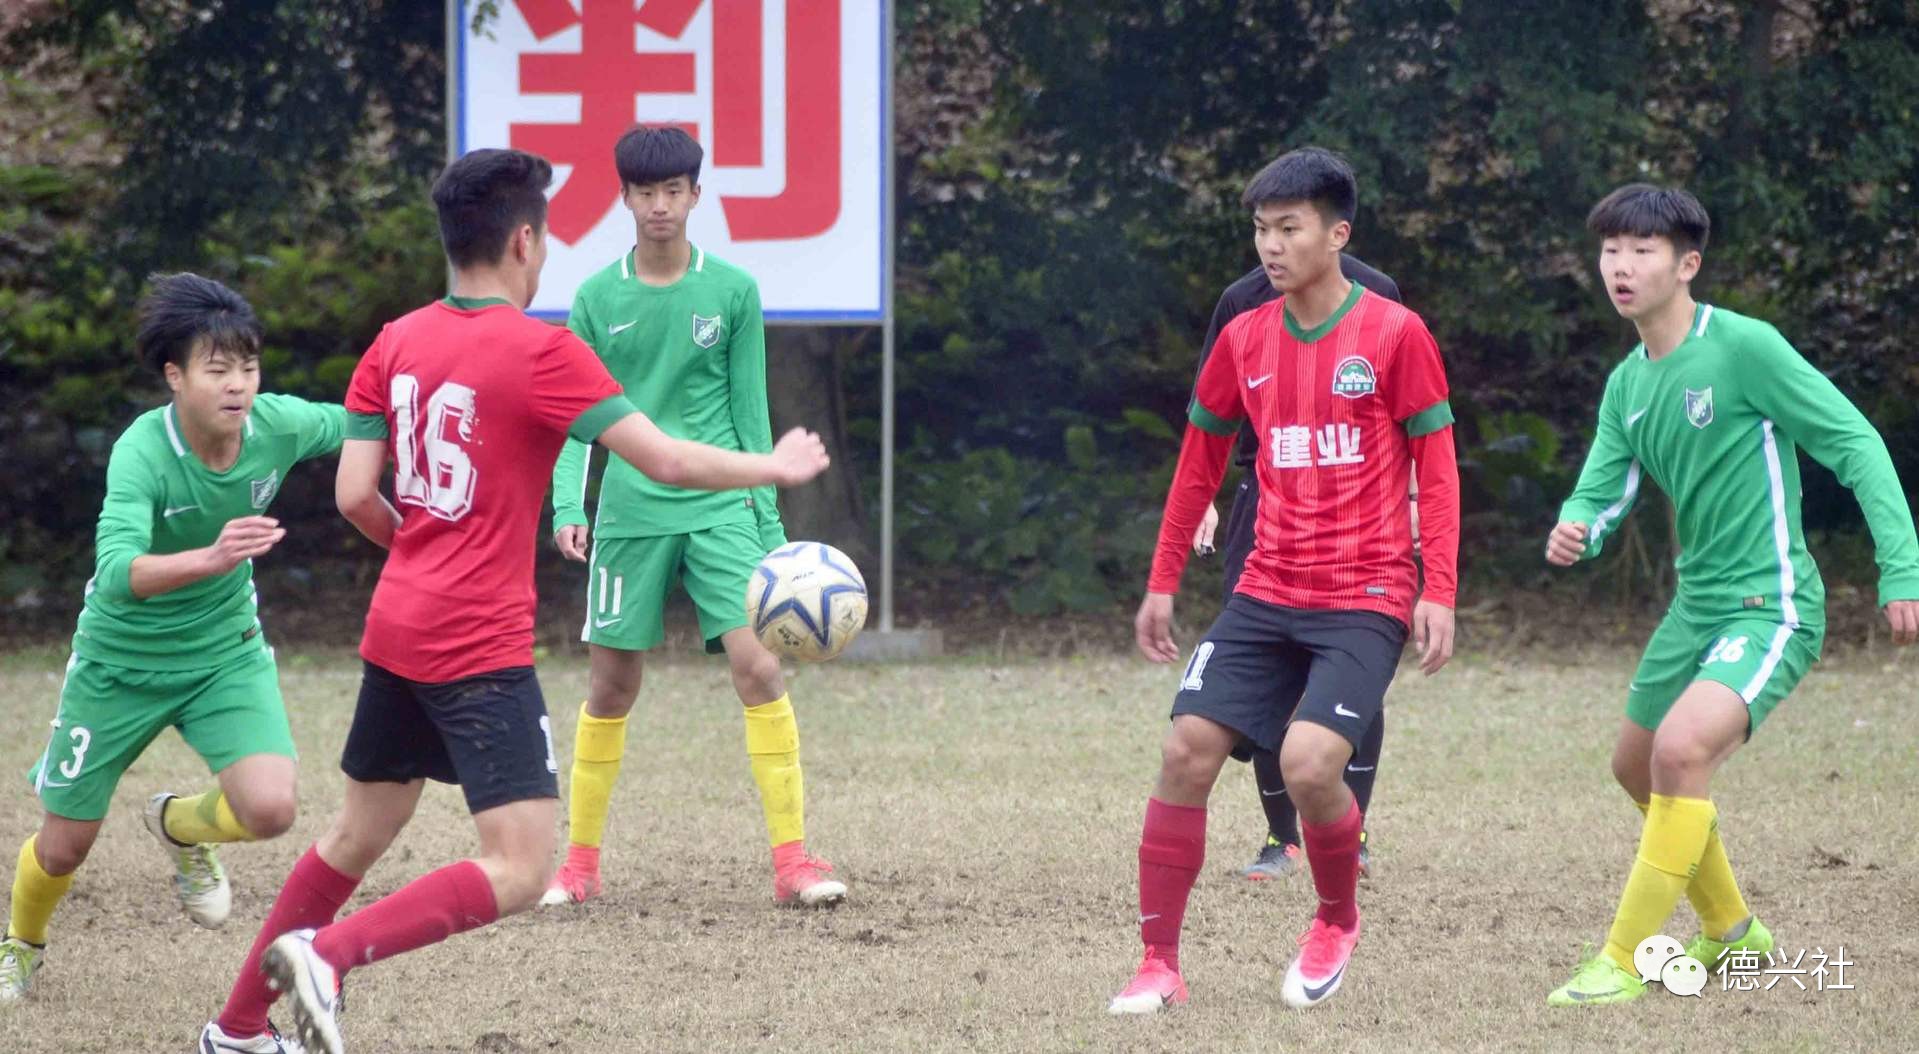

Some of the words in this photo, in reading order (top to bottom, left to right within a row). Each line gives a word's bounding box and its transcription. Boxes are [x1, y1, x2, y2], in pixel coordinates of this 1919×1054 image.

[509, 0, 842, 247] 判
[391, 374, 477, 521] 16
[1270, 423, 1365, 468] 建业
[599, 567, 622, 615] 11
[1704, 635, 1749, 664] 26
[59, 726, 91, 779] 3
